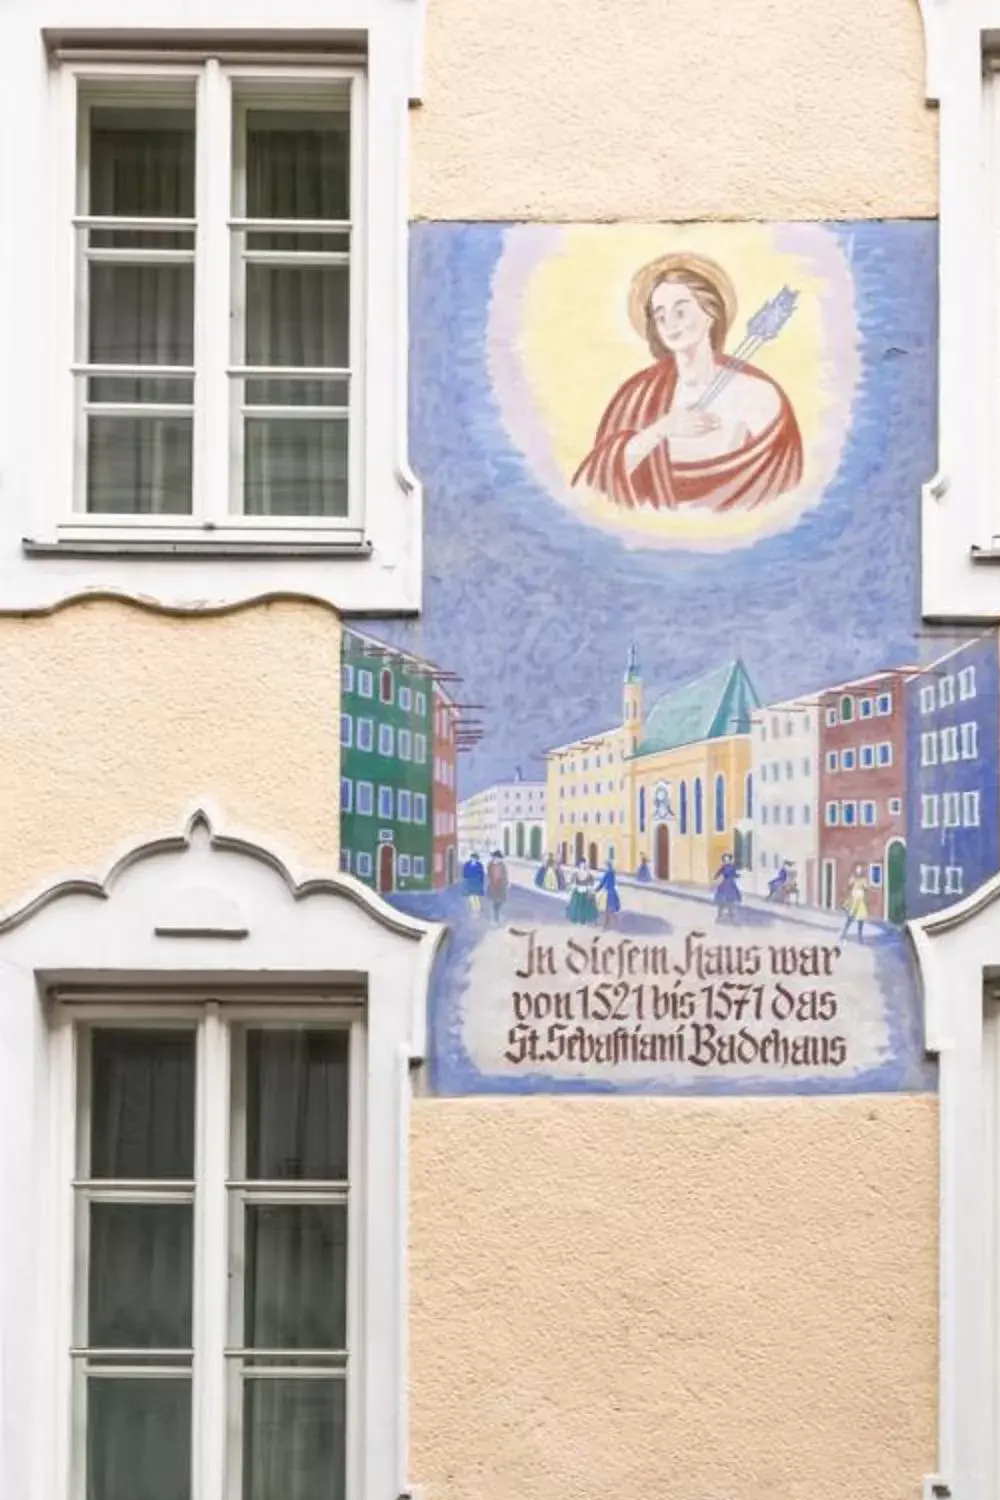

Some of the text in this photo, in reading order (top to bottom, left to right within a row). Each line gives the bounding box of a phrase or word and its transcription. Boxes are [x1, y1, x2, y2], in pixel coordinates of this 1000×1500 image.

[508, 927, 557, 978] In
[673, 931, 762, 980] Haus
[768, 944, 841, 976] war
[512, 980, 838, 1021] von 1521 bis 1571 das
[687, 1023, 847, 1067] Badehaus
